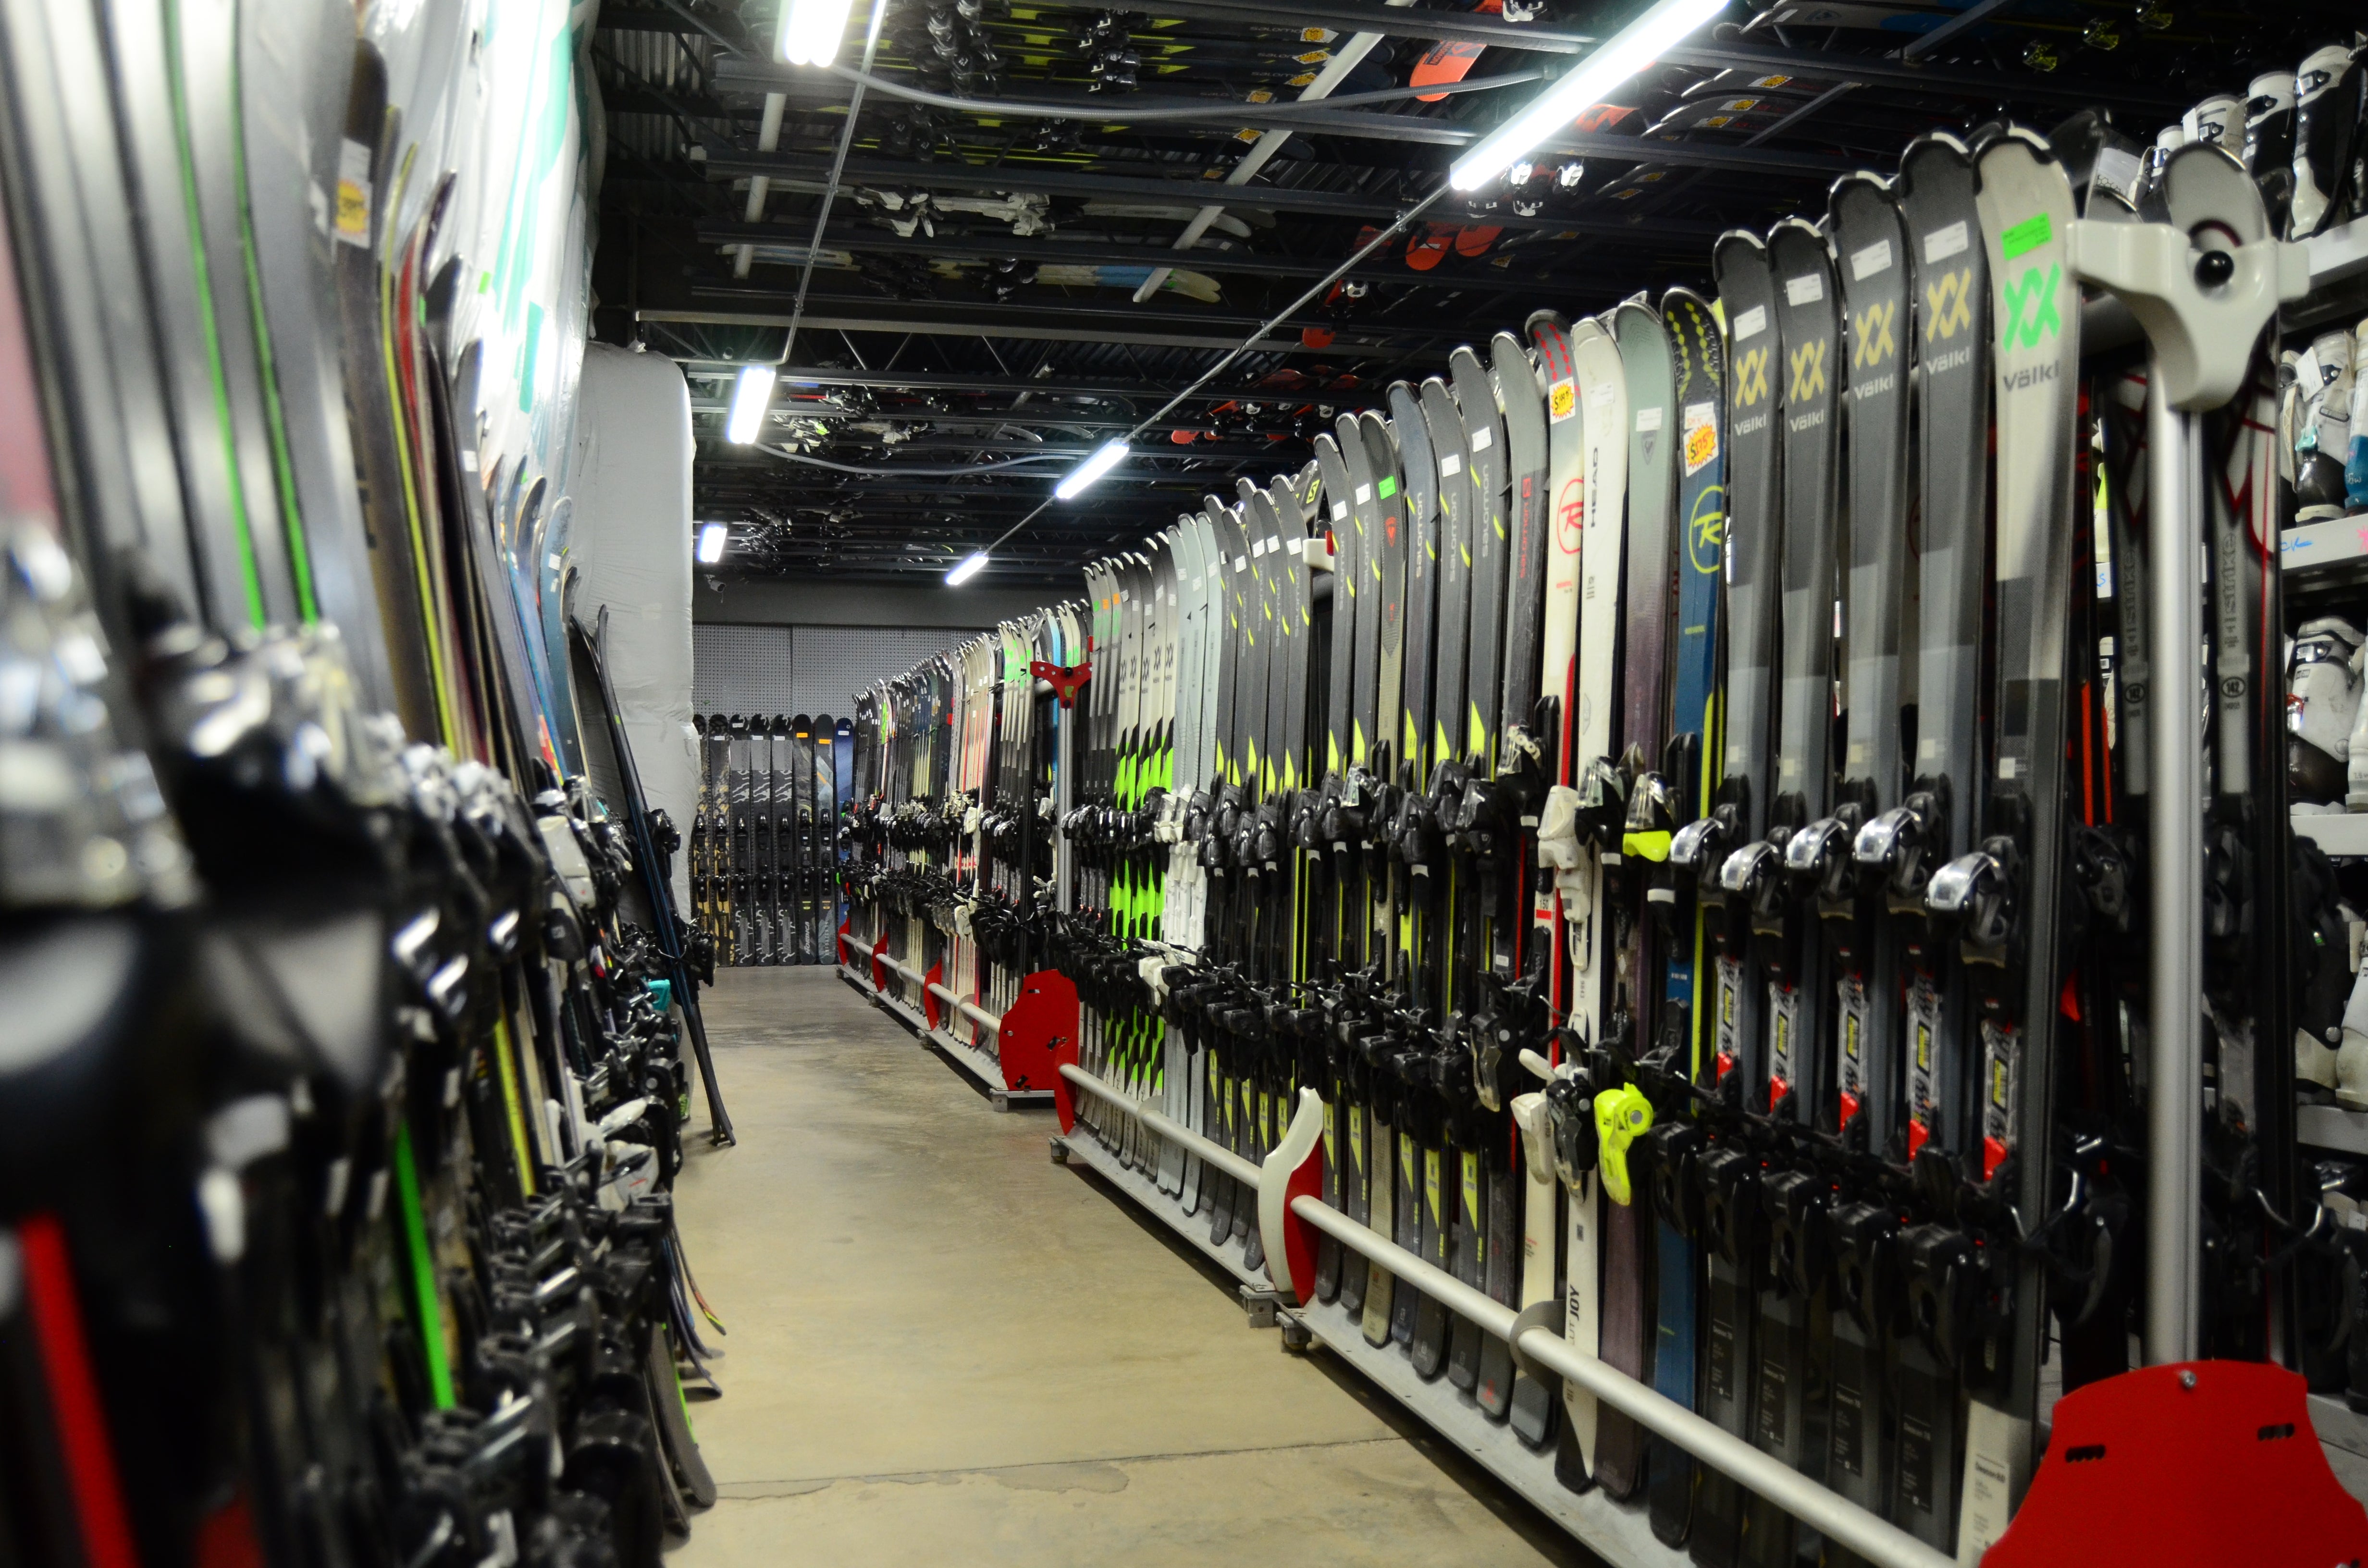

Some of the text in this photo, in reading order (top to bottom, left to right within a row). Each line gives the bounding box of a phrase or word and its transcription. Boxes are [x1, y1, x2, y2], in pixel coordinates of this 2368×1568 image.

[1926, 346, 1971, 375] Völkl
[1853, 373, 1894, 400] Völkl
[2003, 360, 2060, 392] Völkl
[1734, 414, 1767, 436] Völkl
[1789, 410, 1824, 432] Völkl
[1591, 447, 1599, 528] HEAD
[1520, 502, 1529, 579] salomon
[1540, 899, 1549, 910] 150
[1569, 1284, 1580, 1322] JOY
